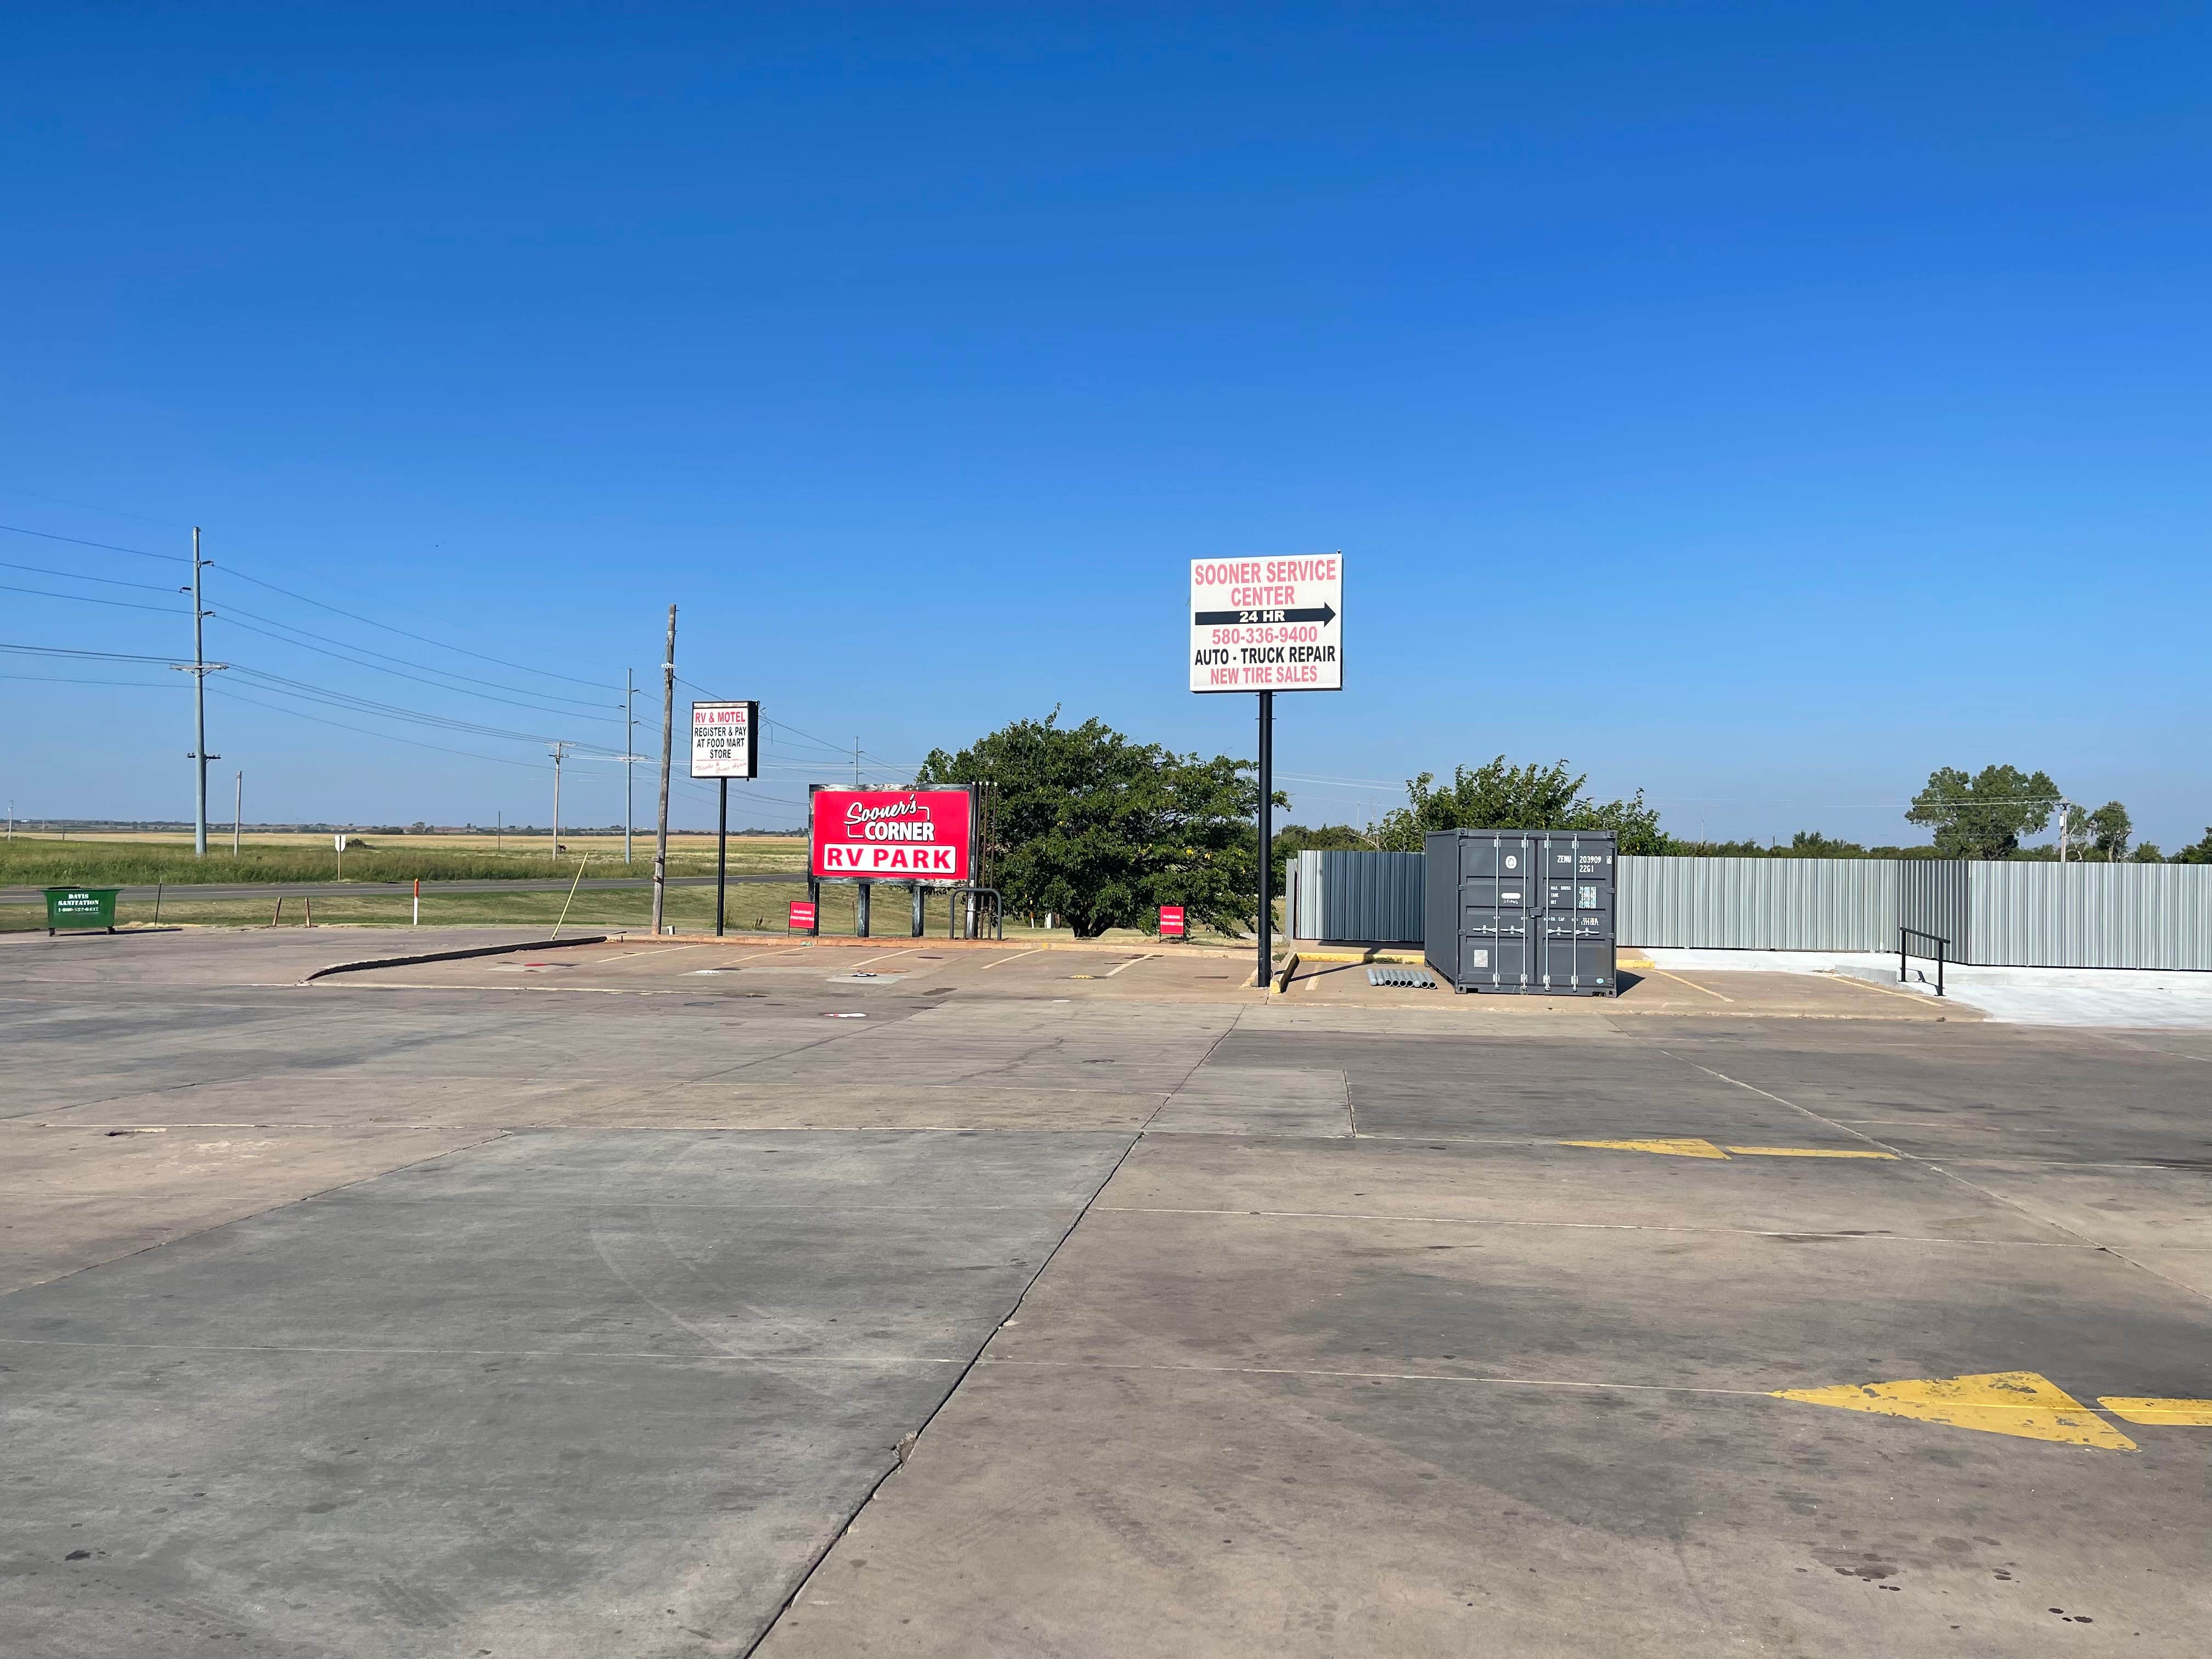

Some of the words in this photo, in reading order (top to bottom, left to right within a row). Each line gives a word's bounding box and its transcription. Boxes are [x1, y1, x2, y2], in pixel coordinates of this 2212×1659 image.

[1195, 562, 1261, 585] SOONER
[1267, 560, 1336, 583] SERVICE
[1231, 585, 1295, 606] CENTER
[1239, 611, 1259, 623] 24
[1263, 610, 1285, 622] HR
[1212, 626, 1318, 645] 580-336-9400
[1195, 648, 1229, 665] AUTO
[1241, 647, 1285, 664] TRUCK
[1289, 645, 1336, 663] REPAIR
[1211, 668, 1239, 685] NEW
[1243, 667, 1272, 683] TIRE
[1277, 665, 1317, 682] SALES
[695, 712, 706, 723] RV
[709, 712, 714, 723] &
[718, 712, 745, 723] MOTEL
[695, 727, 726, 736] REGISTER
[729, 727, 733, 736] &
[735, 726, 746, 736] PAY
[697, 739, 705, 748] AT
[707, 738, 724, 747] FOOD
[726, 738, 744, 747] MART
[710, 749, 731, 758] STORE
[843, 794, 917, 825] Sooner's
[864, 821, 935, 842] CORNER
[827, 848, 864, 866] RV
[873, 849, 951, 869] PARK
[1579, 855, 1601, 864] 203909
